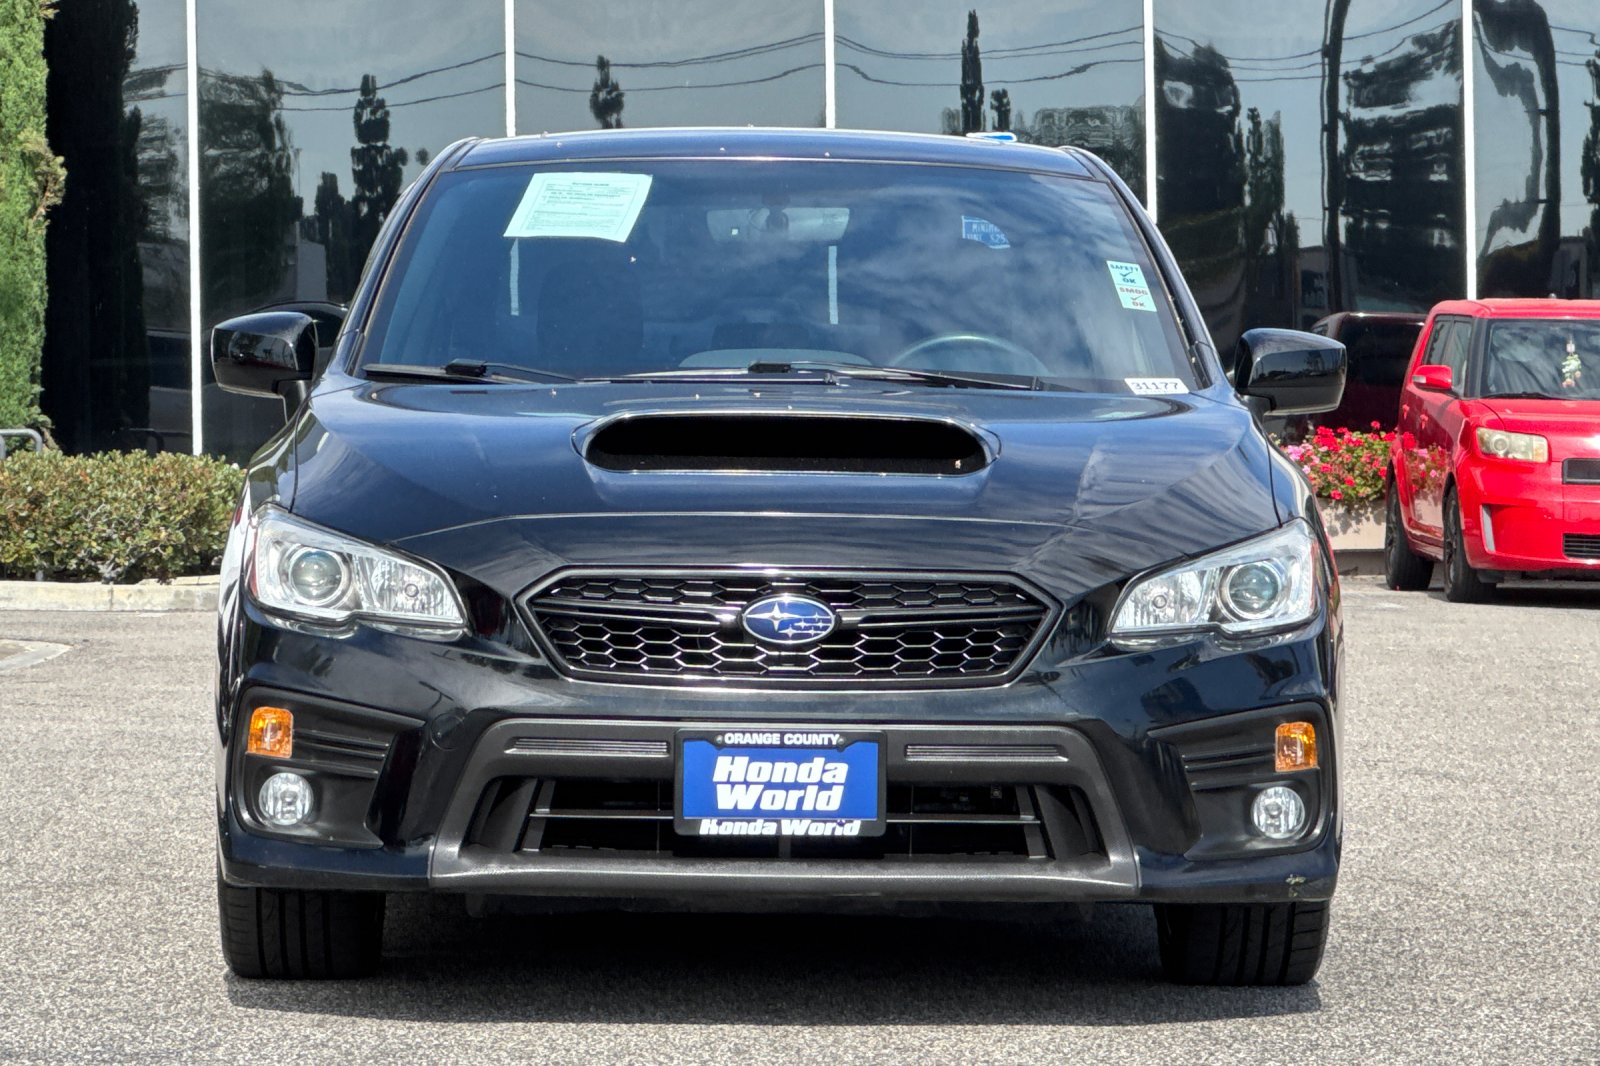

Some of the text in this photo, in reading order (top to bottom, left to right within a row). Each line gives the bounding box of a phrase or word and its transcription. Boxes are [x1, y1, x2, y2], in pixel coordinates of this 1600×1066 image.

[1109, 263, 1139, 272] SAFETY
[1119, 286, 1149, 296] SMOG
[1130, 381, 1179, 390] 31177
[724, 732, 840, 746] ORANGE COUNTY
[712, 755, 849, 784] Honda
[716, 784, 845, 811] World
[699, 818, 862, 837] Honda World
